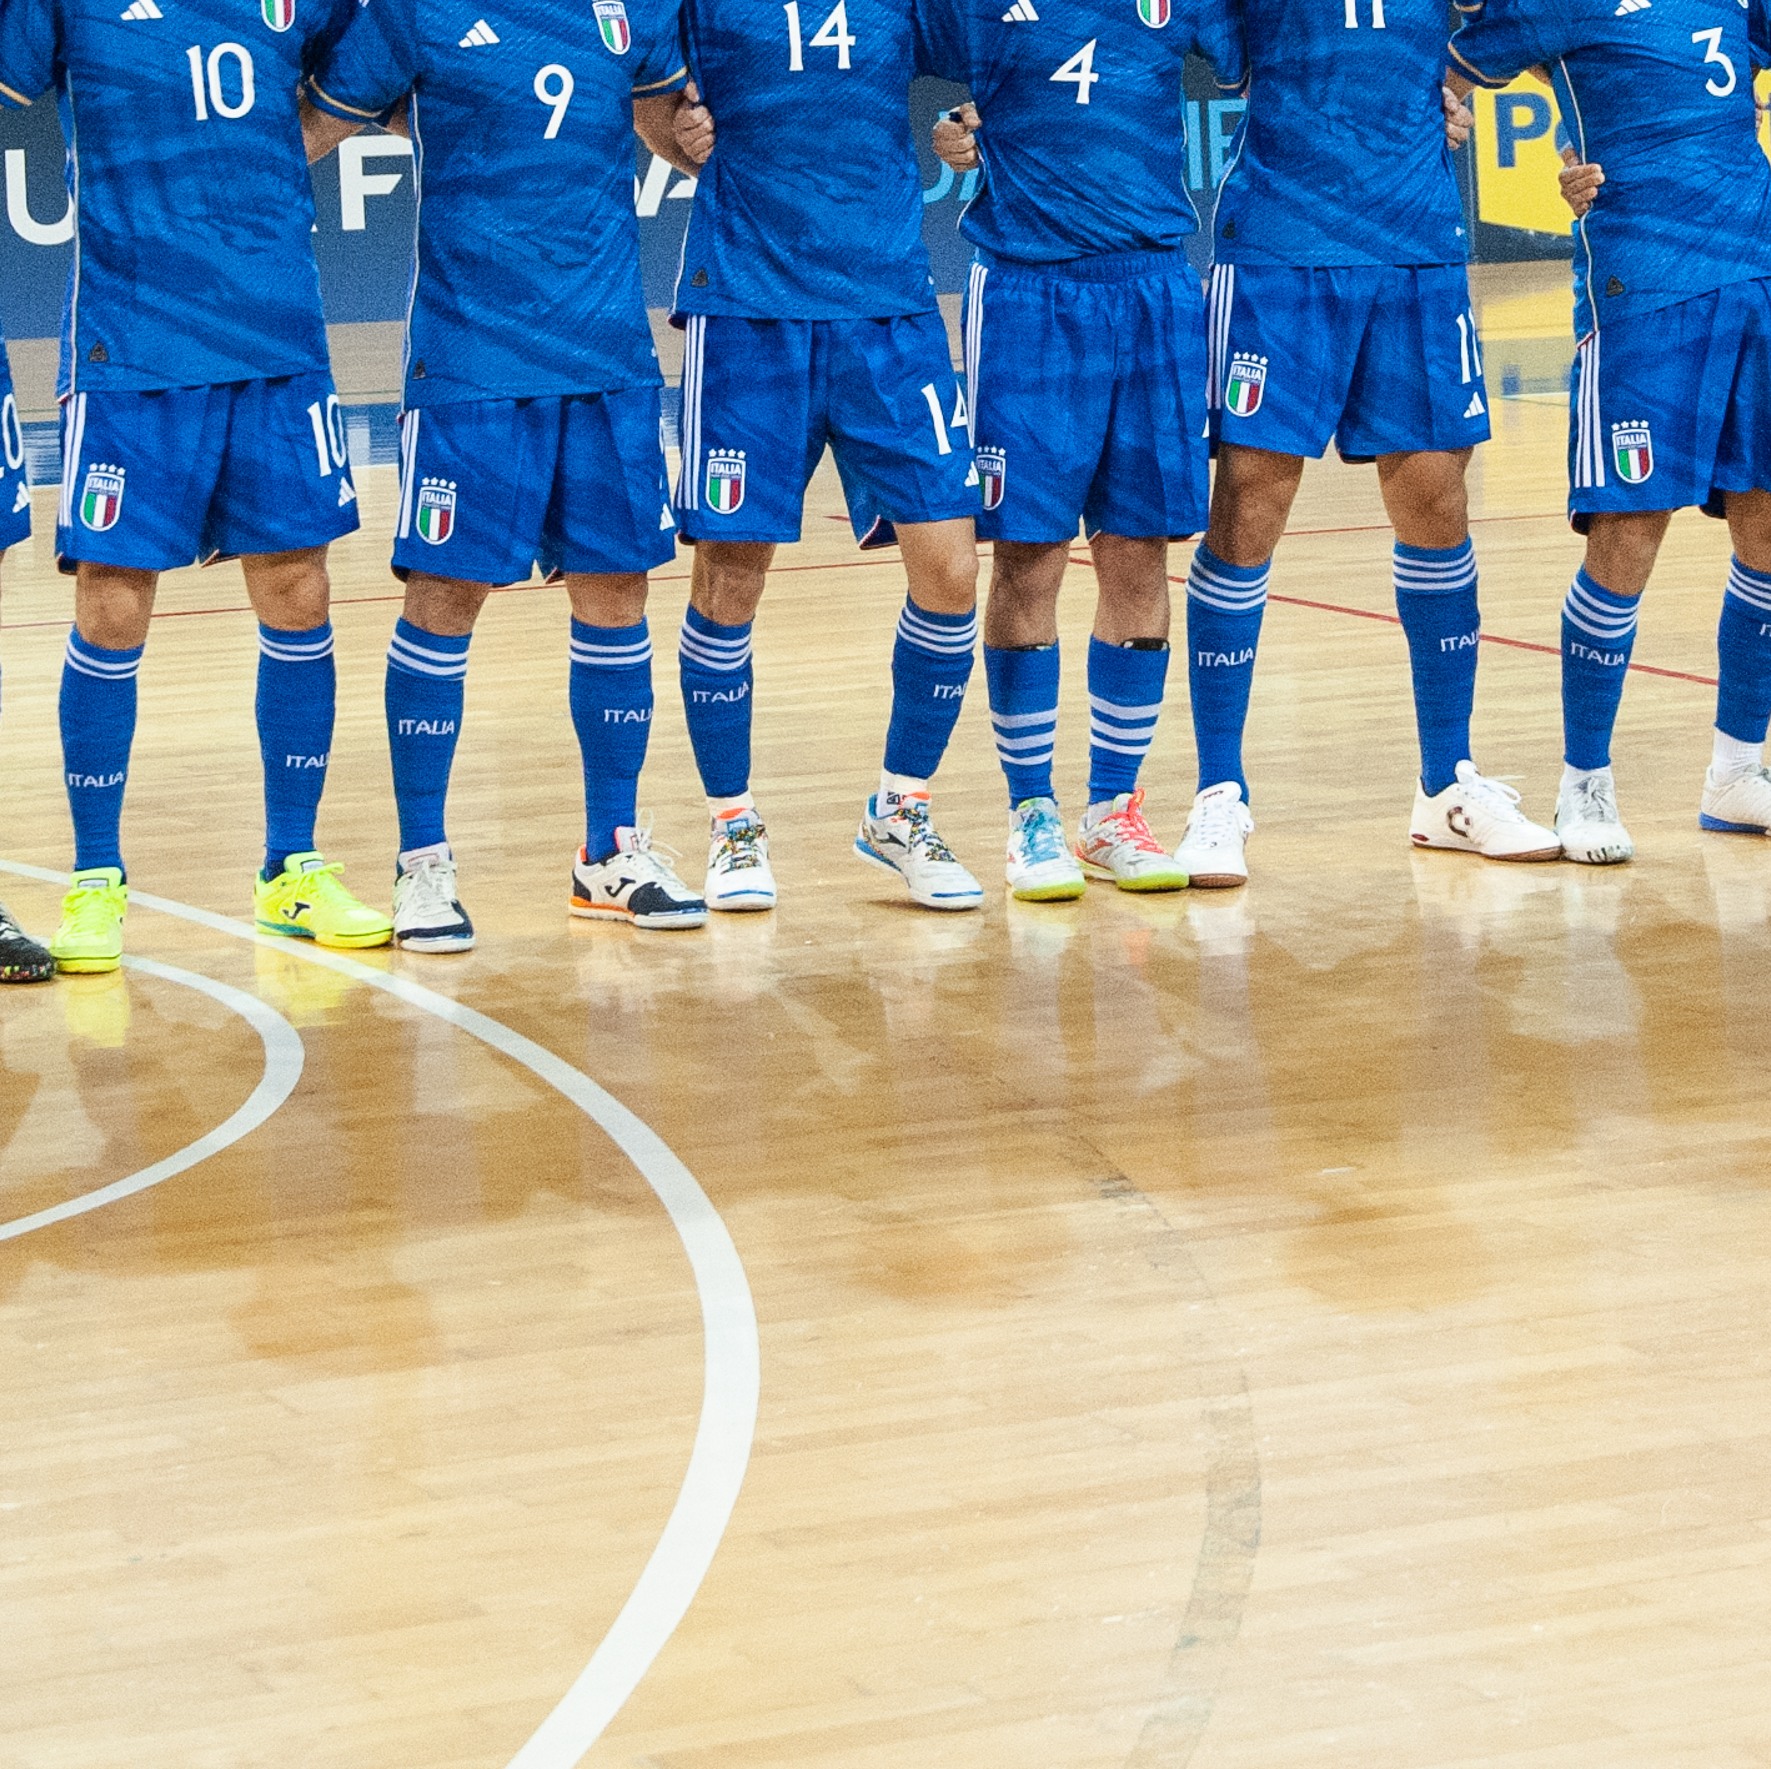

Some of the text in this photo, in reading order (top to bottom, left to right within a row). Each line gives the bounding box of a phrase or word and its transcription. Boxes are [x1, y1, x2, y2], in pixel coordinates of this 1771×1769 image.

[1049, 37, 1100, 105] 4
[1690, 26, 1736, 98] 3
[186, 42, 256, 121] 10
[533, 63, 575, 140] 9
[1231, 365, 1265, 380] ITALIA
[922, 382, 968, 456] 14
[307, 393, 347, 479] 10
[1616, 431, 1650, 447] ITALIA
[710, 460, 745, 476] ITALIA
[87, 475, 120, 492] ITALIA
[421, 491, 454, 507] ITALIA
[1198, 646, 1255, 669] ITALIA
[1569, 641, 1627, 667] ITALIA
[692, 680, 750, 704] ITALIA
[398, 718, 456, 736] ITALIA
[66, 771, 125, 789] ITALIA
